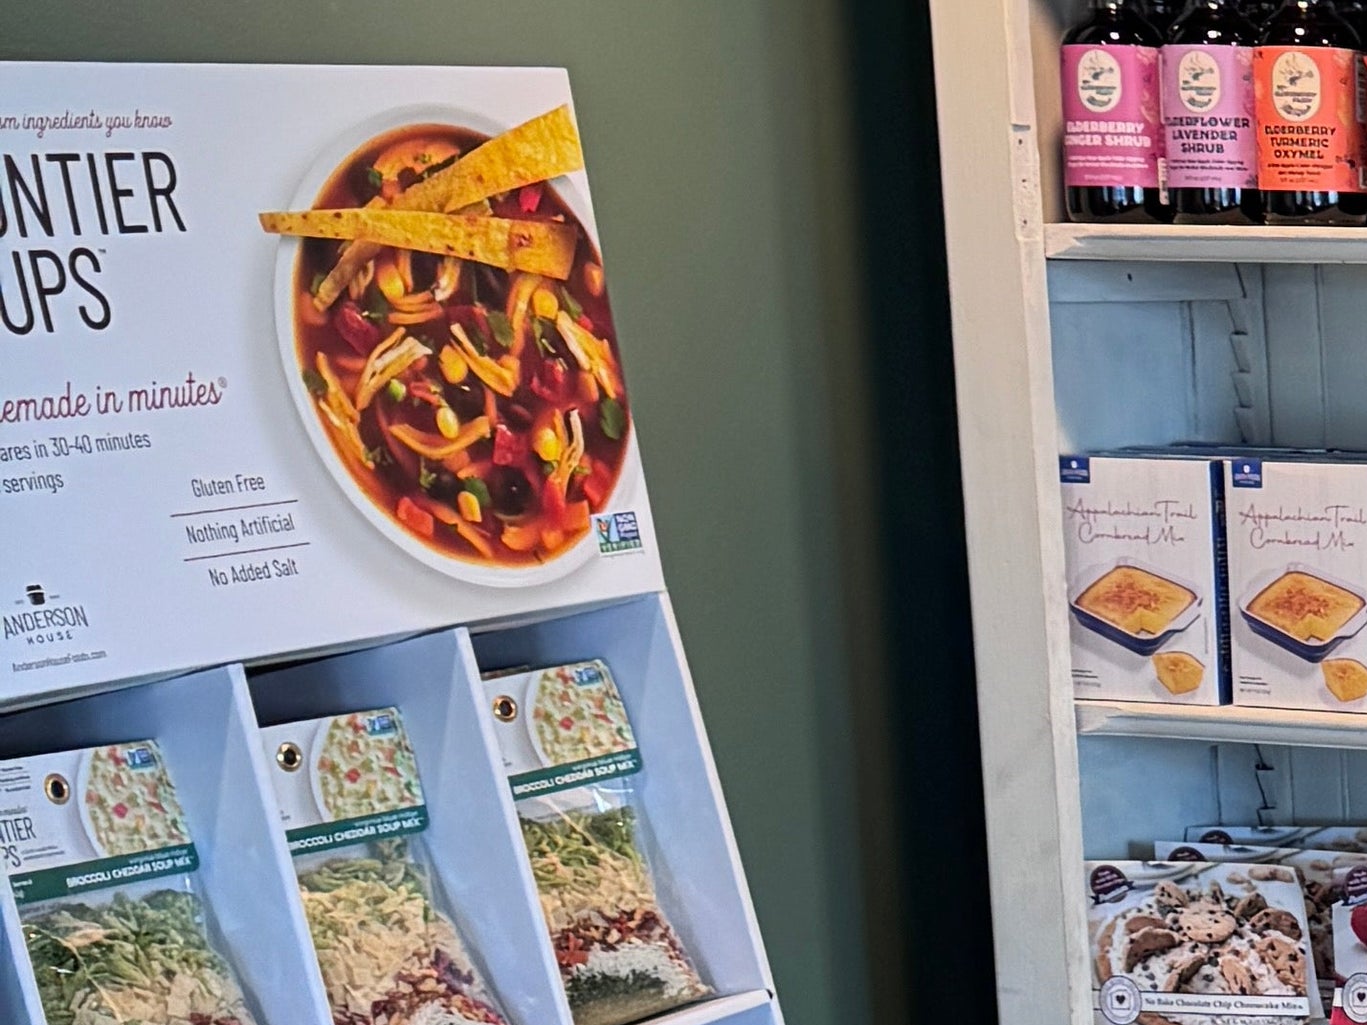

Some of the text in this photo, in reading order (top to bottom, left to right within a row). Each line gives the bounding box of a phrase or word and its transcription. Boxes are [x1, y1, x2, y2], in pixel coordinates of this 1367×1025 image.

[22, 109, 173, 138] ingredients you know
[1265, 124, 1336, 136] ELDERBERRY
[1181, 142, 1225, 154] SHRUB
[1270, 137, 1329, 148] TURMERIC
[1274, 149, 1325, 160] OXYMEL
[97, 385, 123, 414] in
[50, 435, 93, 457] 30-40
[95, 432, 152, 452] minutes
[2, 472, 65, 494] servings
[191, 473, 265, 498] Gluten Free
[186, 512, 295, 546] Nothing Artificial
[209, 557, 300, 587] No Added Salt
[3, 605, 90, 640] ANDERSON
[26, 630, 74, 646] HOUSE
